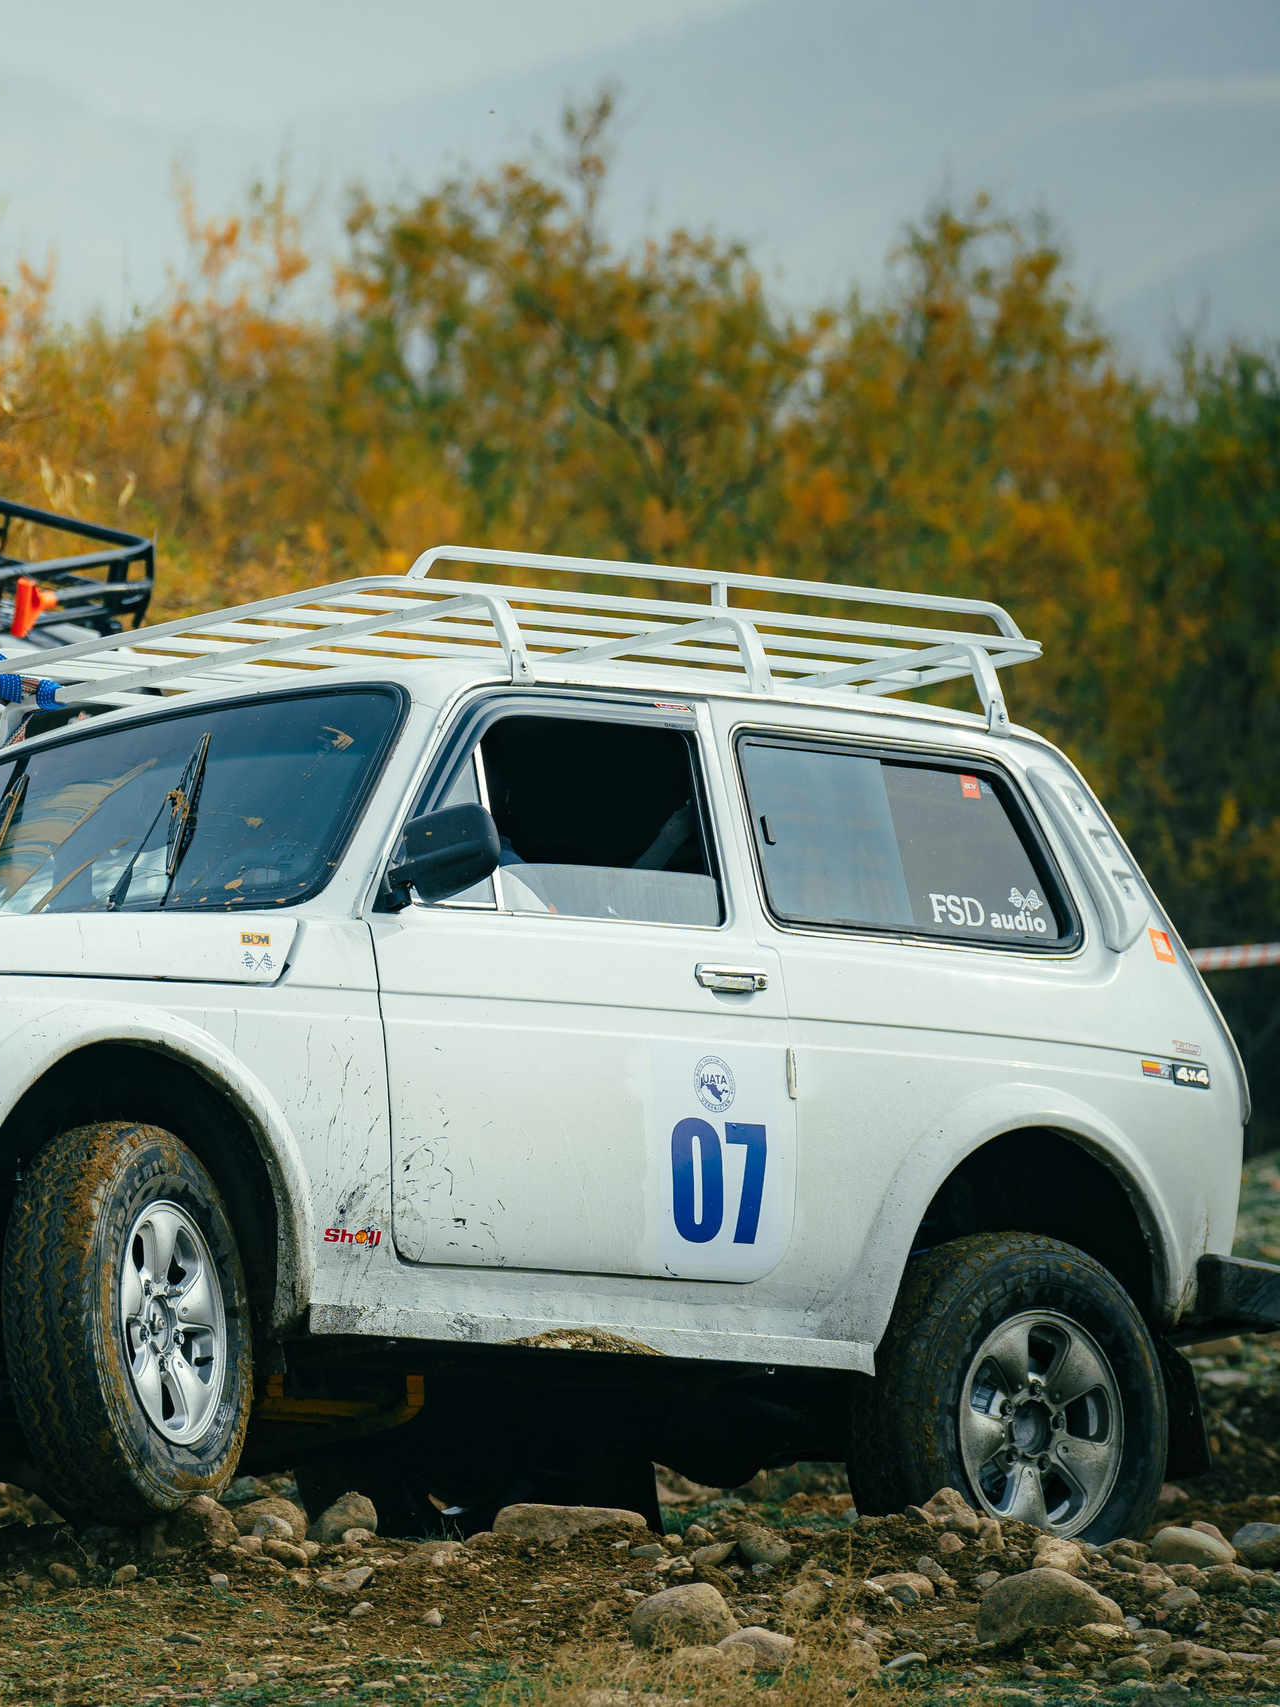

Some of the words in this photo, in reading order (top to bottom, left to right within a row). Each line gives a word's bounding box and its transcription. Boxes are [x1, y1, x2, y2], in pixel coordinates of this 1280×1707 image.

[929, 893, 985, 927] FSD
[990, 911, 1047, 933] audio
[702, 1073, 728, 1085] UATA
[1176, 1066, 1210, 1085] 4x4
[671, 1117, 767, 1244] 07
